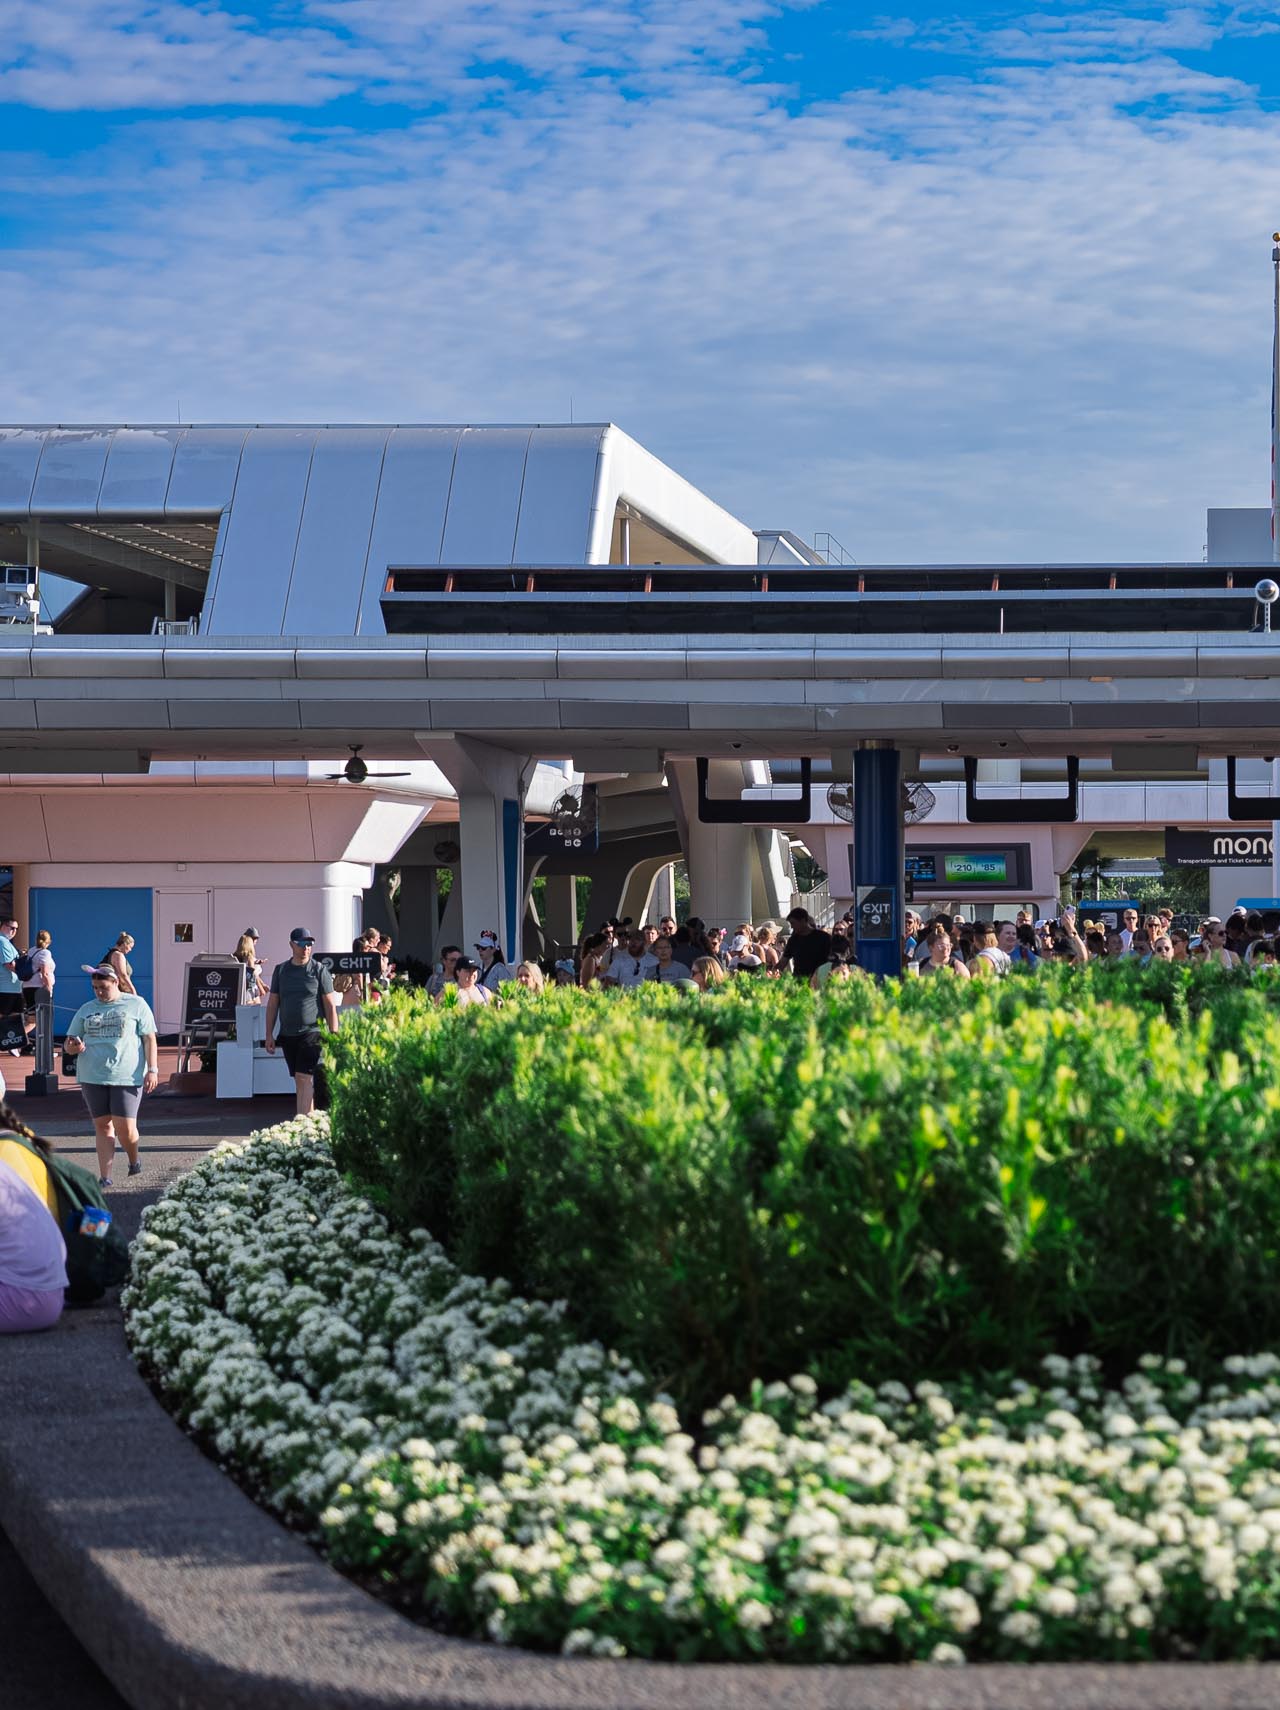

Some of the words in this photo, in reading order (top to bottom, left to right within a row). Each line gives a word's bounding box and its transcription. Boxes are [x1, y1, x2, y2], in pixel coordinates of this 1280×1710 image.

[862, 903, 890, 913] EXIT
[339, 957, 372, 969] EXIT
[198, 989, 228, 999] PARK
[200, 1000, 225, 1008] EXIT
